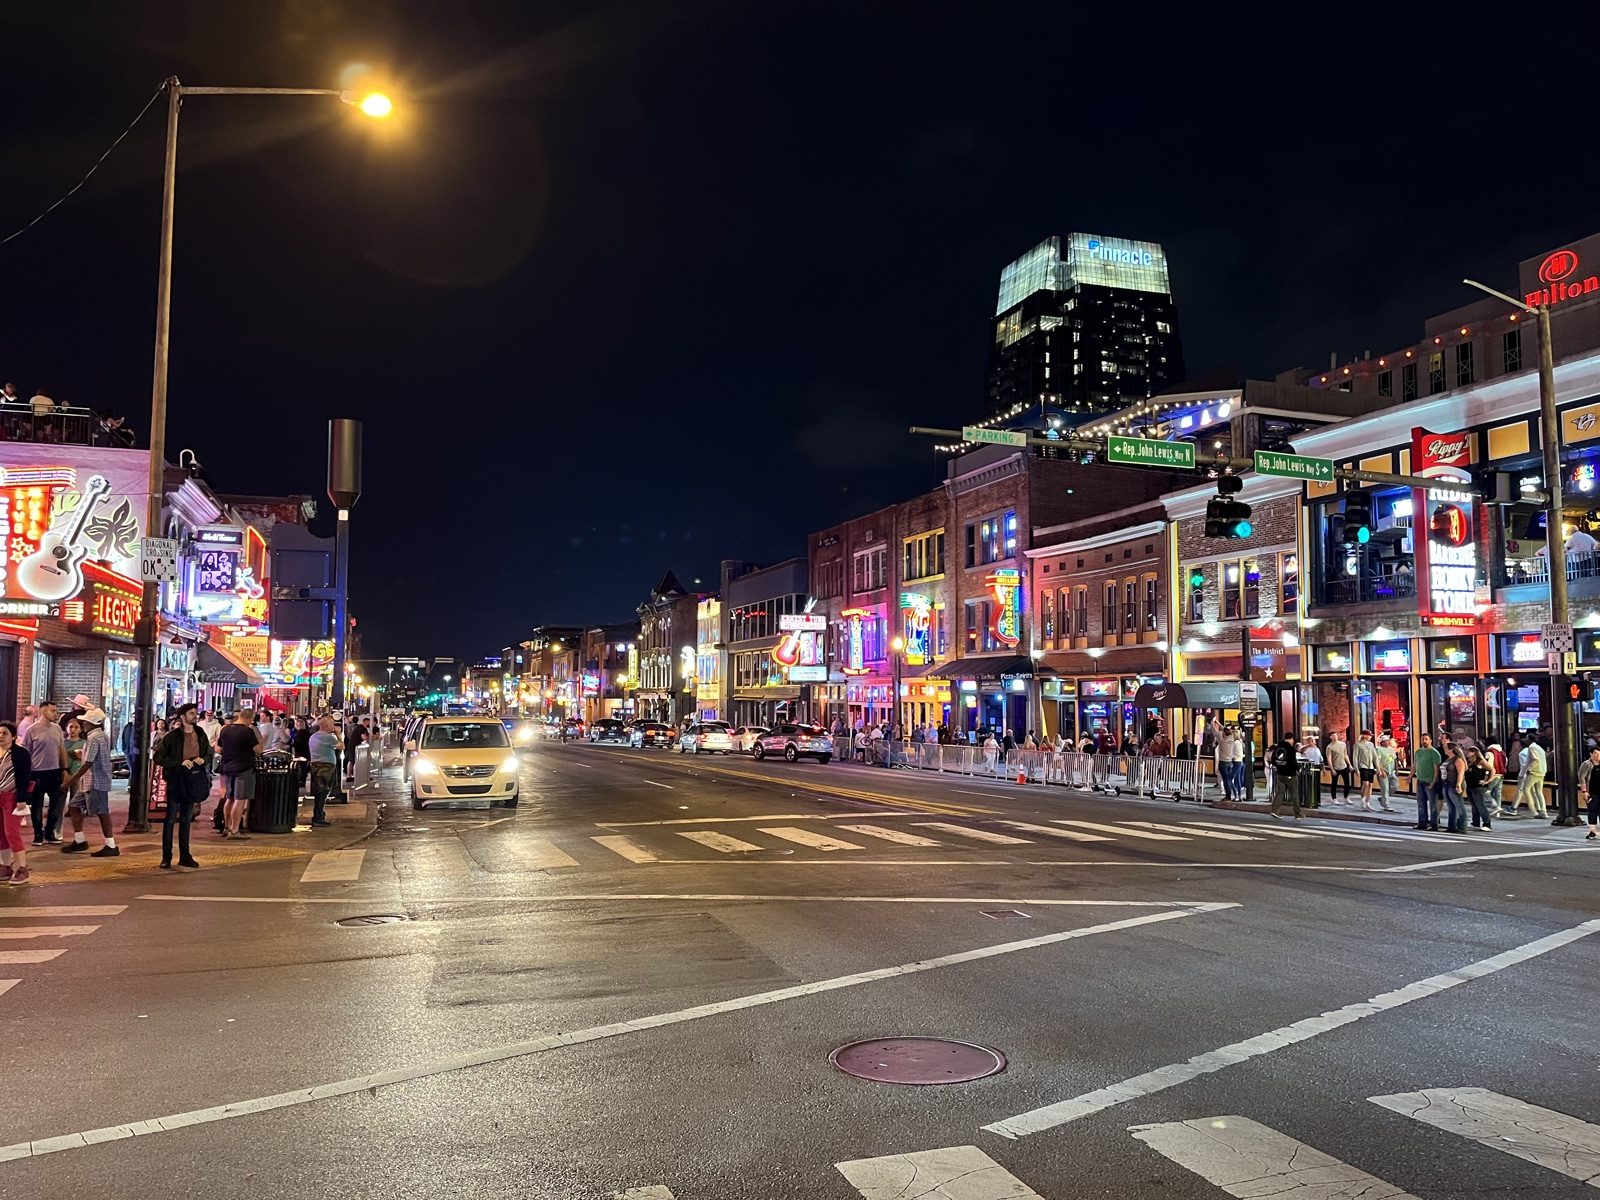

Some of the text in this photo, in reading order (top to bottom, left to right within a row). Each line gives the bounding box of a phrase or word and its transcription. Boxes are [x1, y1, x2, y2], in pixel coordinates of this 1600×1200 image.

[1088, 240, 1153, 266] Pinnacle
[1525, 275, 1599, 311] Hilton
[975, 430, 1015, 444] PARKING
[1122, 441, 1137, 458] Rep.
[1138, 443, 1153, 457] John
[1154, 444, 1173, 459] Lewis
[1185, 448, 1191, 462] N
[1258, 454, 1273, 471] Rep.
[1273, 456, 1287, 471] John
[1287, 458, 1305, 473] Lewis
[1315, 462, 1320, 476] S
[145, 540, 173, 549] DIAGONAL
[145, 548, 173, 558] CROSSING
[142, 559, 156, 575] OK
[1430, 617, 1475, 627] NASHVILLE
[1543, 638, 1555, 649] OK
[1252, 647, 1285, 656] The District
[207, 666, 238, 675] Second
[206, 673, 237, 682] Fiddle
[1219, 691, 1239, 703] Rippy's
